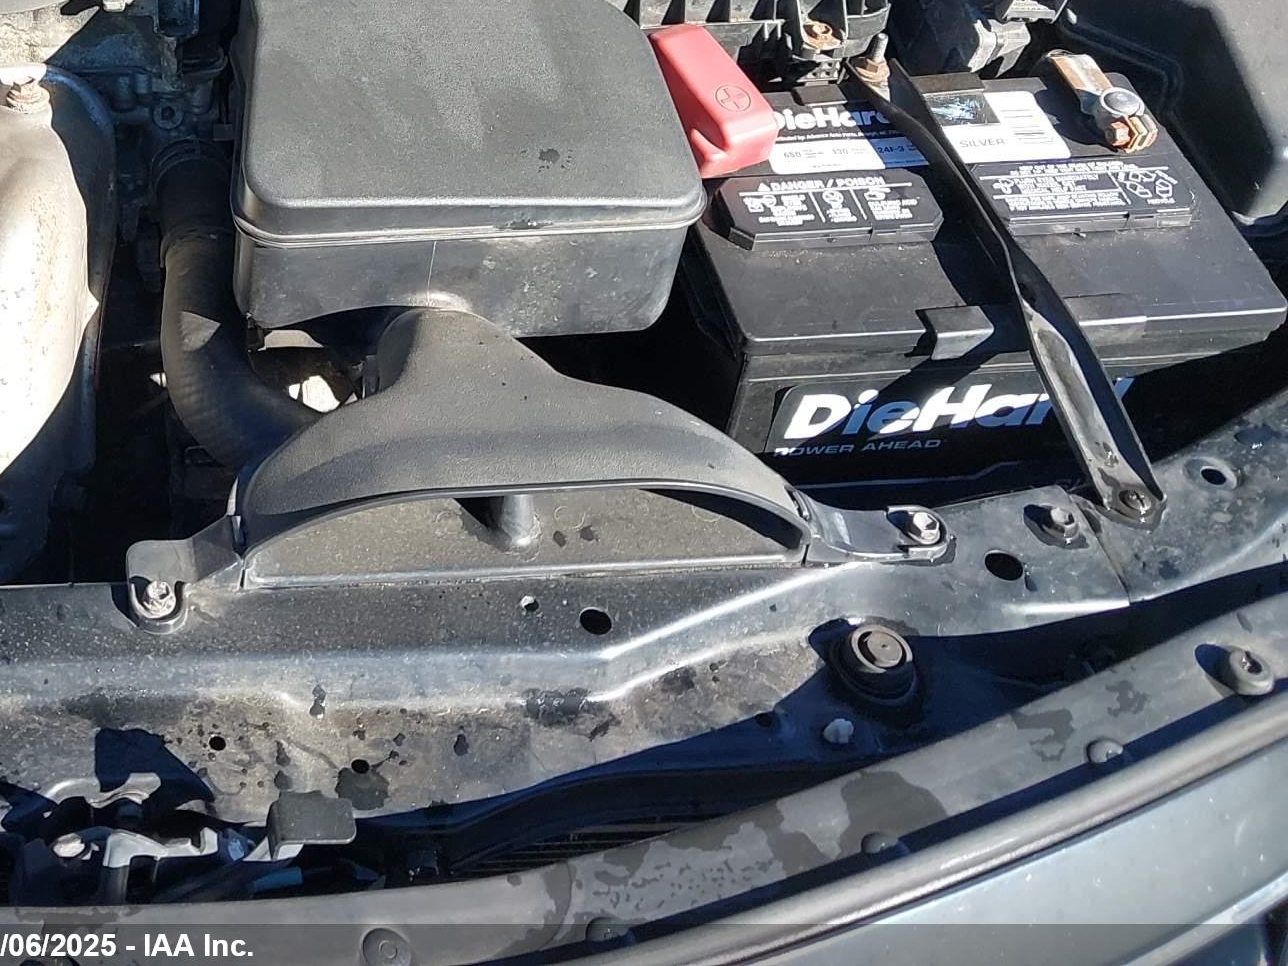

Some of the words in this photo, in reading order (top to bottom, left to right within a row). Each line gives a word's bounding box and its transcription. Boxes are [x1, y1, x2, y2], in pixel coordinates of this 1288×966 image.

[959, 137, 1006, 148] SILVER
[770, 180, 824, 191] DANGER
[835, 176, 886, 188] POISON
[784, 378, 1133, 439] DieHar
[773, 443, 855, 457] POWER
[861, 439, 942, 452] AHEAD
